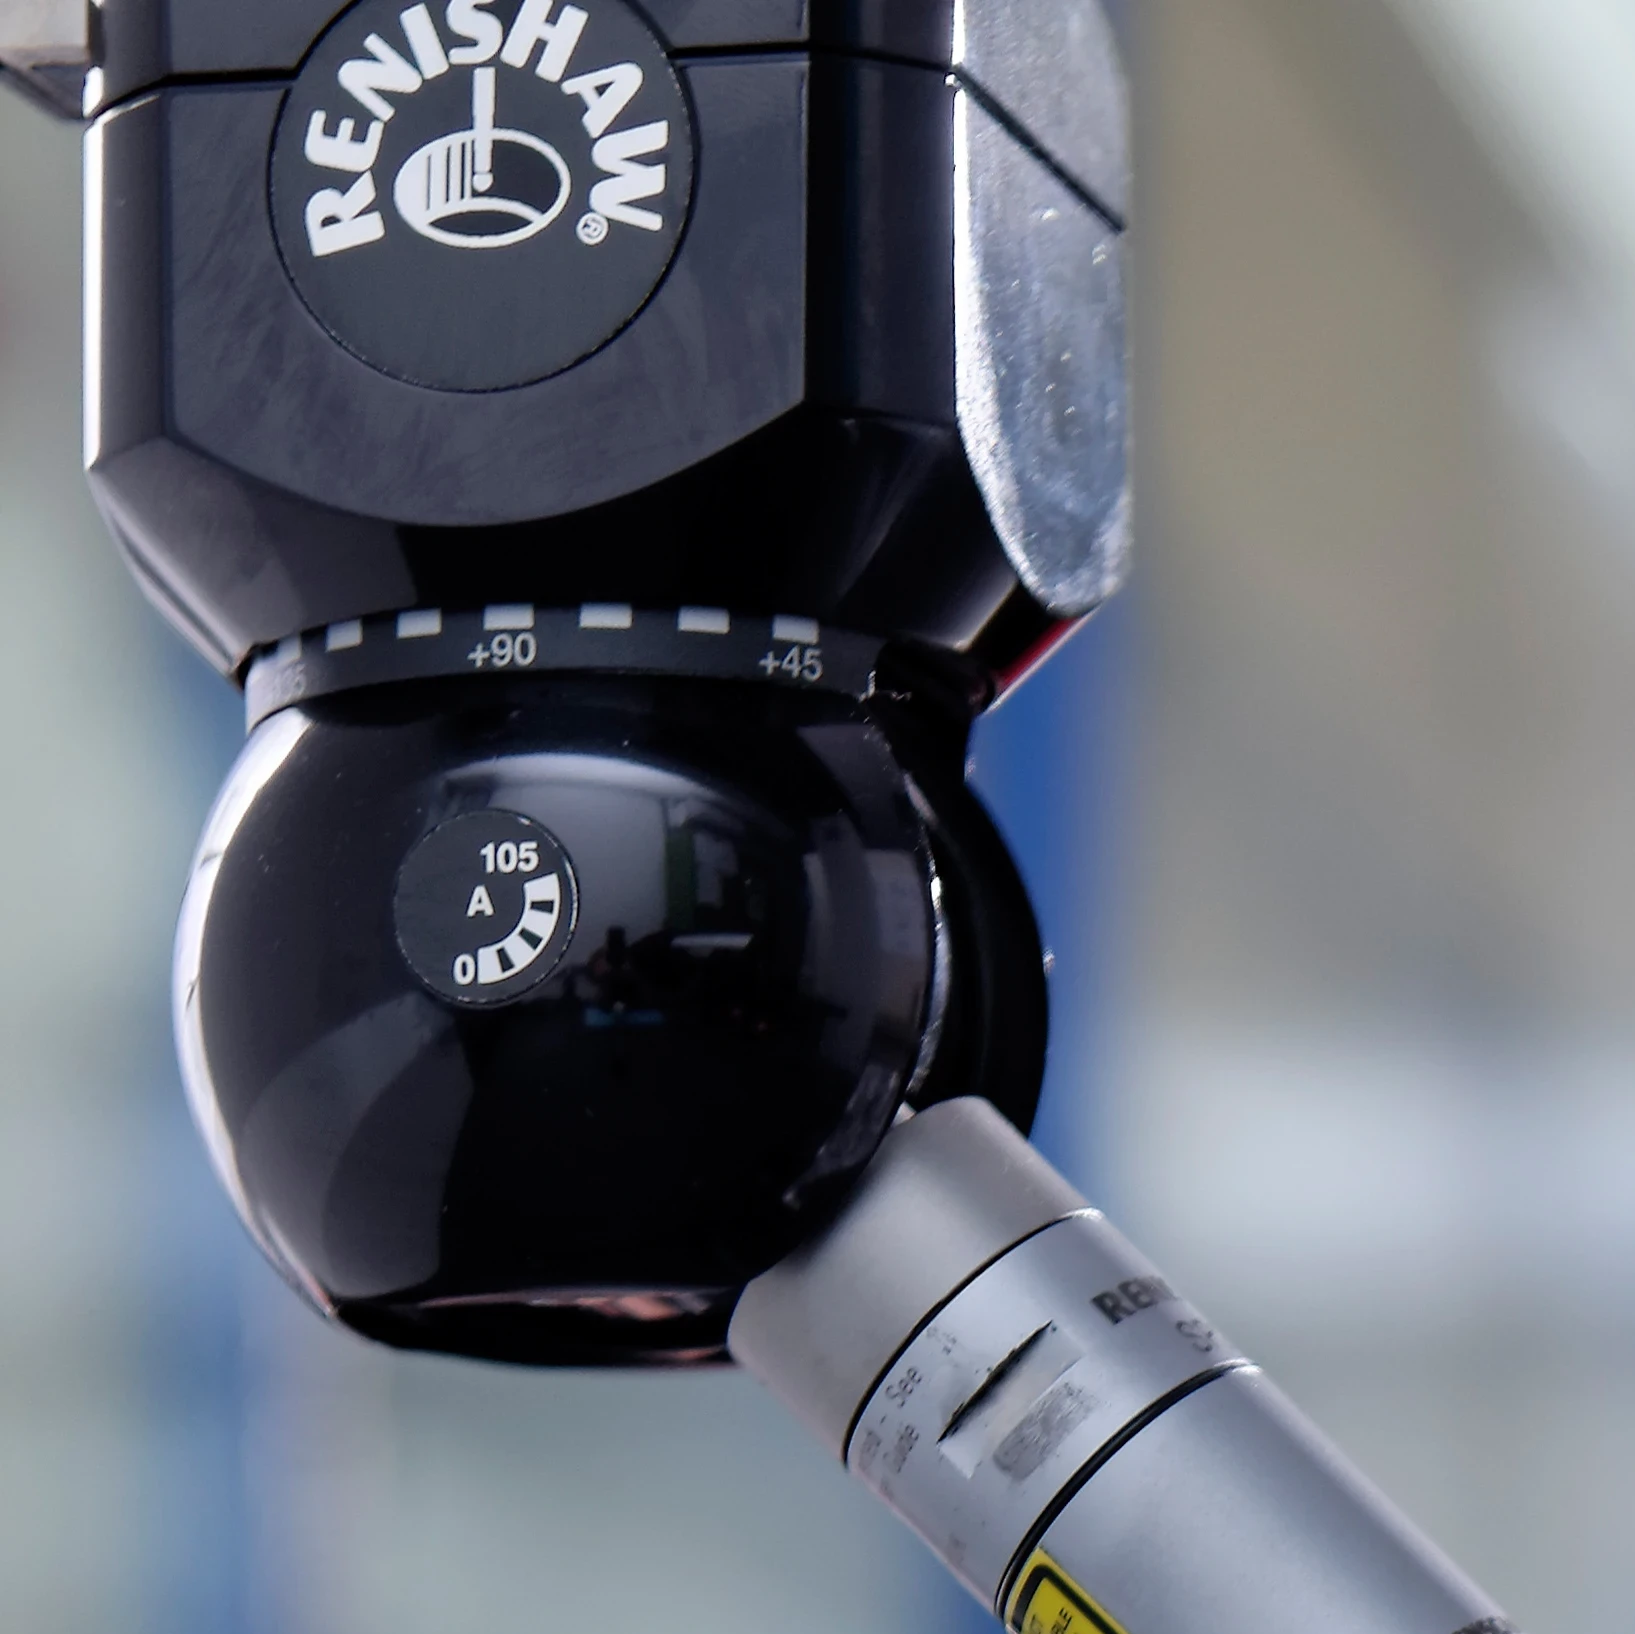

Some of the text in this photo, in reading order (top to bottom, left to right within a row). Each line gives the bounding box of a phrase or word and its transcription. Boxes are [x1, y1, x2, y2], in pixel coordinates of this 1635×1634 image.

[467, 632, 537, 668] +90
[759, 645, 823, 682] +45
[480, 841, 539, 874] 105
[466, 885, 495, 917] A
[453, 953, 476, 985] 0
